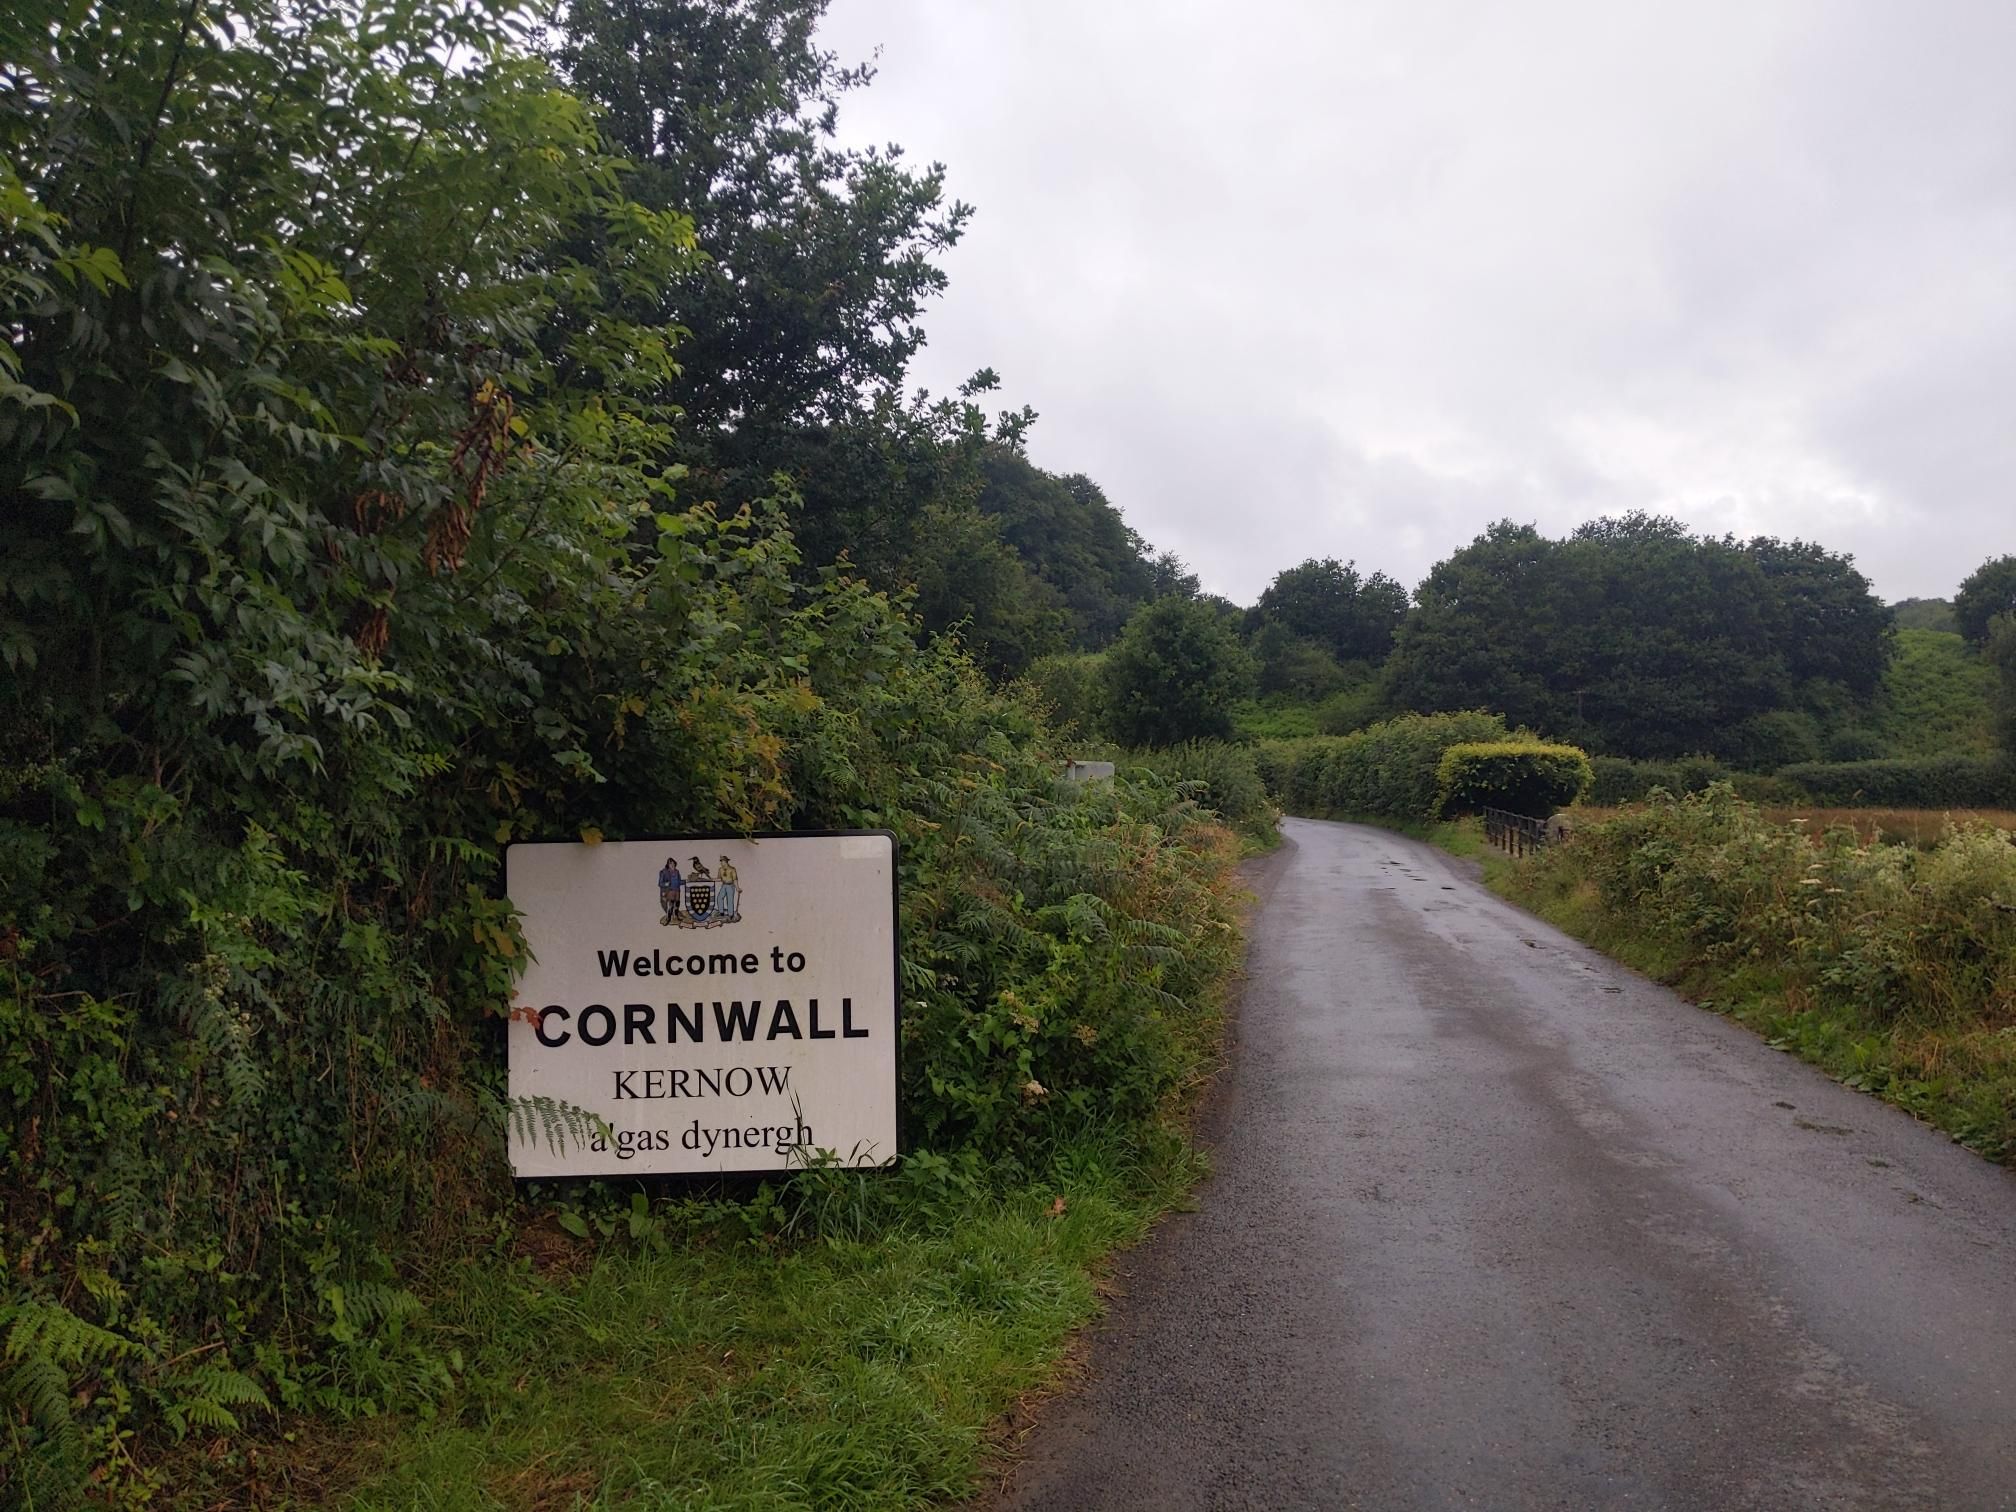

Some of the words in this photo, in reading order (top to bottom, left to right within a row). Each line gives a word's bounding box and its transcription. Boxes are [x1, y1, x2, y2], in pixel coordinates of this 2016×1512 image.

[597, 949, 759, 977] Welcome
[770, 946, 806, 973] to
[535, 998, 869, 1047] CORNWALL
[612, 1066, 793, 1099] KERNOW
[681, 1120, 814, 1156] dynergh
